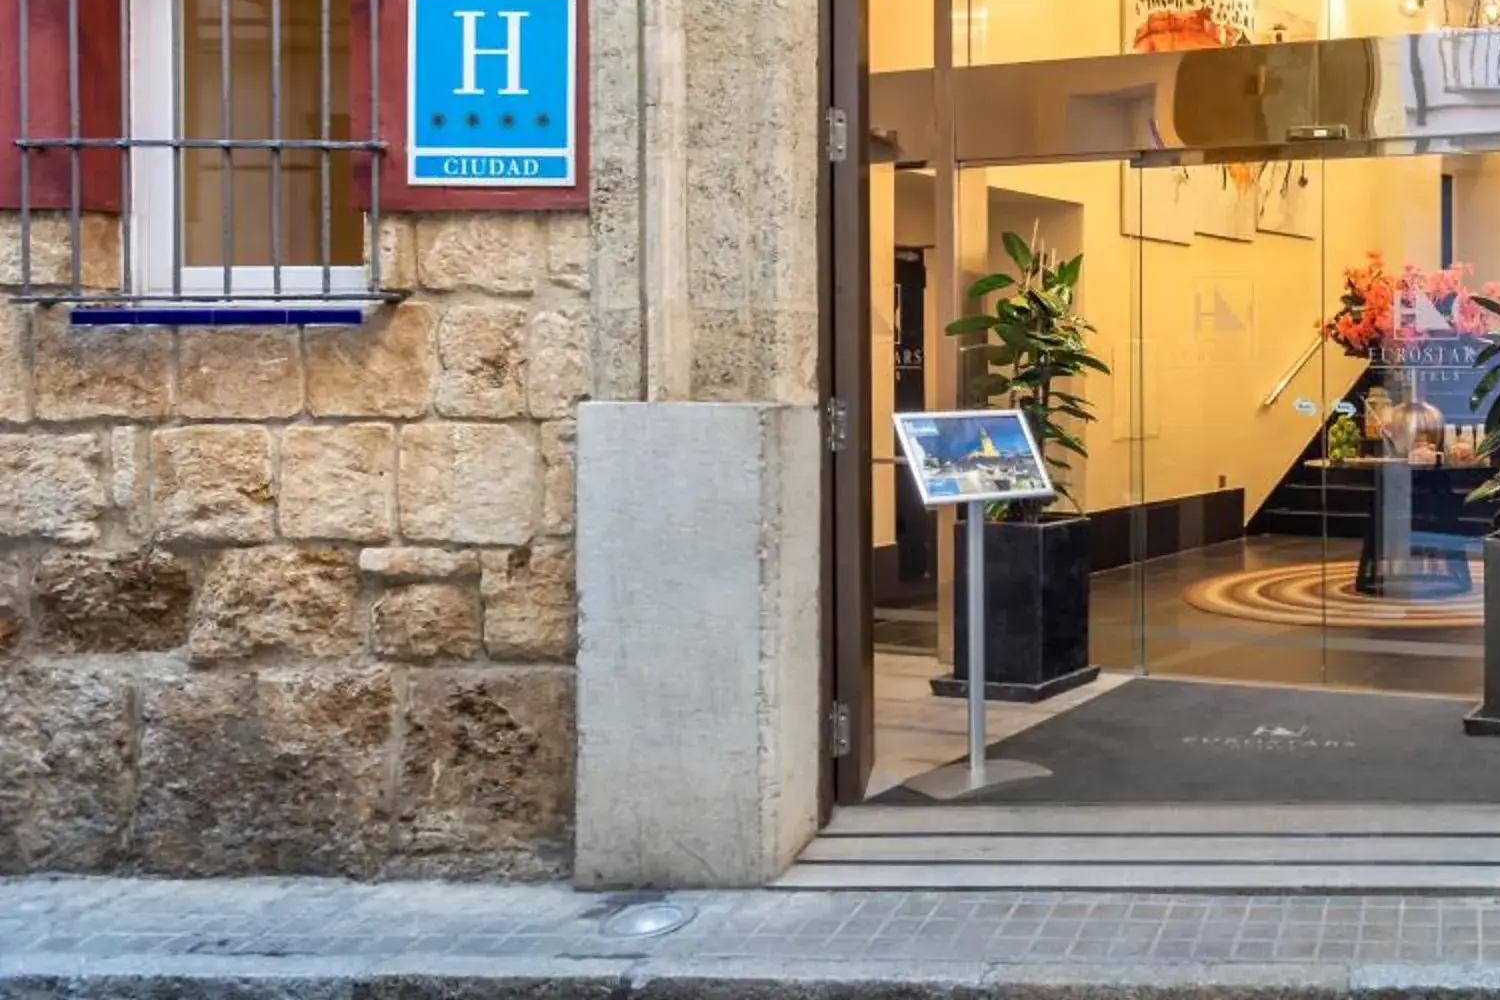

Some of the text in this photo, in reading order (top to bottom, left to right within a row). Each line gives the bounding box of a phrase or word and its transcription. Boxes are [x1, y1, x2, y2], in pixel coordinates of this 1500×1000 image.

[453, 10, 531, 95] H
[443, 158, 540, 177] CIUDAD
[1367, 346, 1478, 364] EUROSTAR
